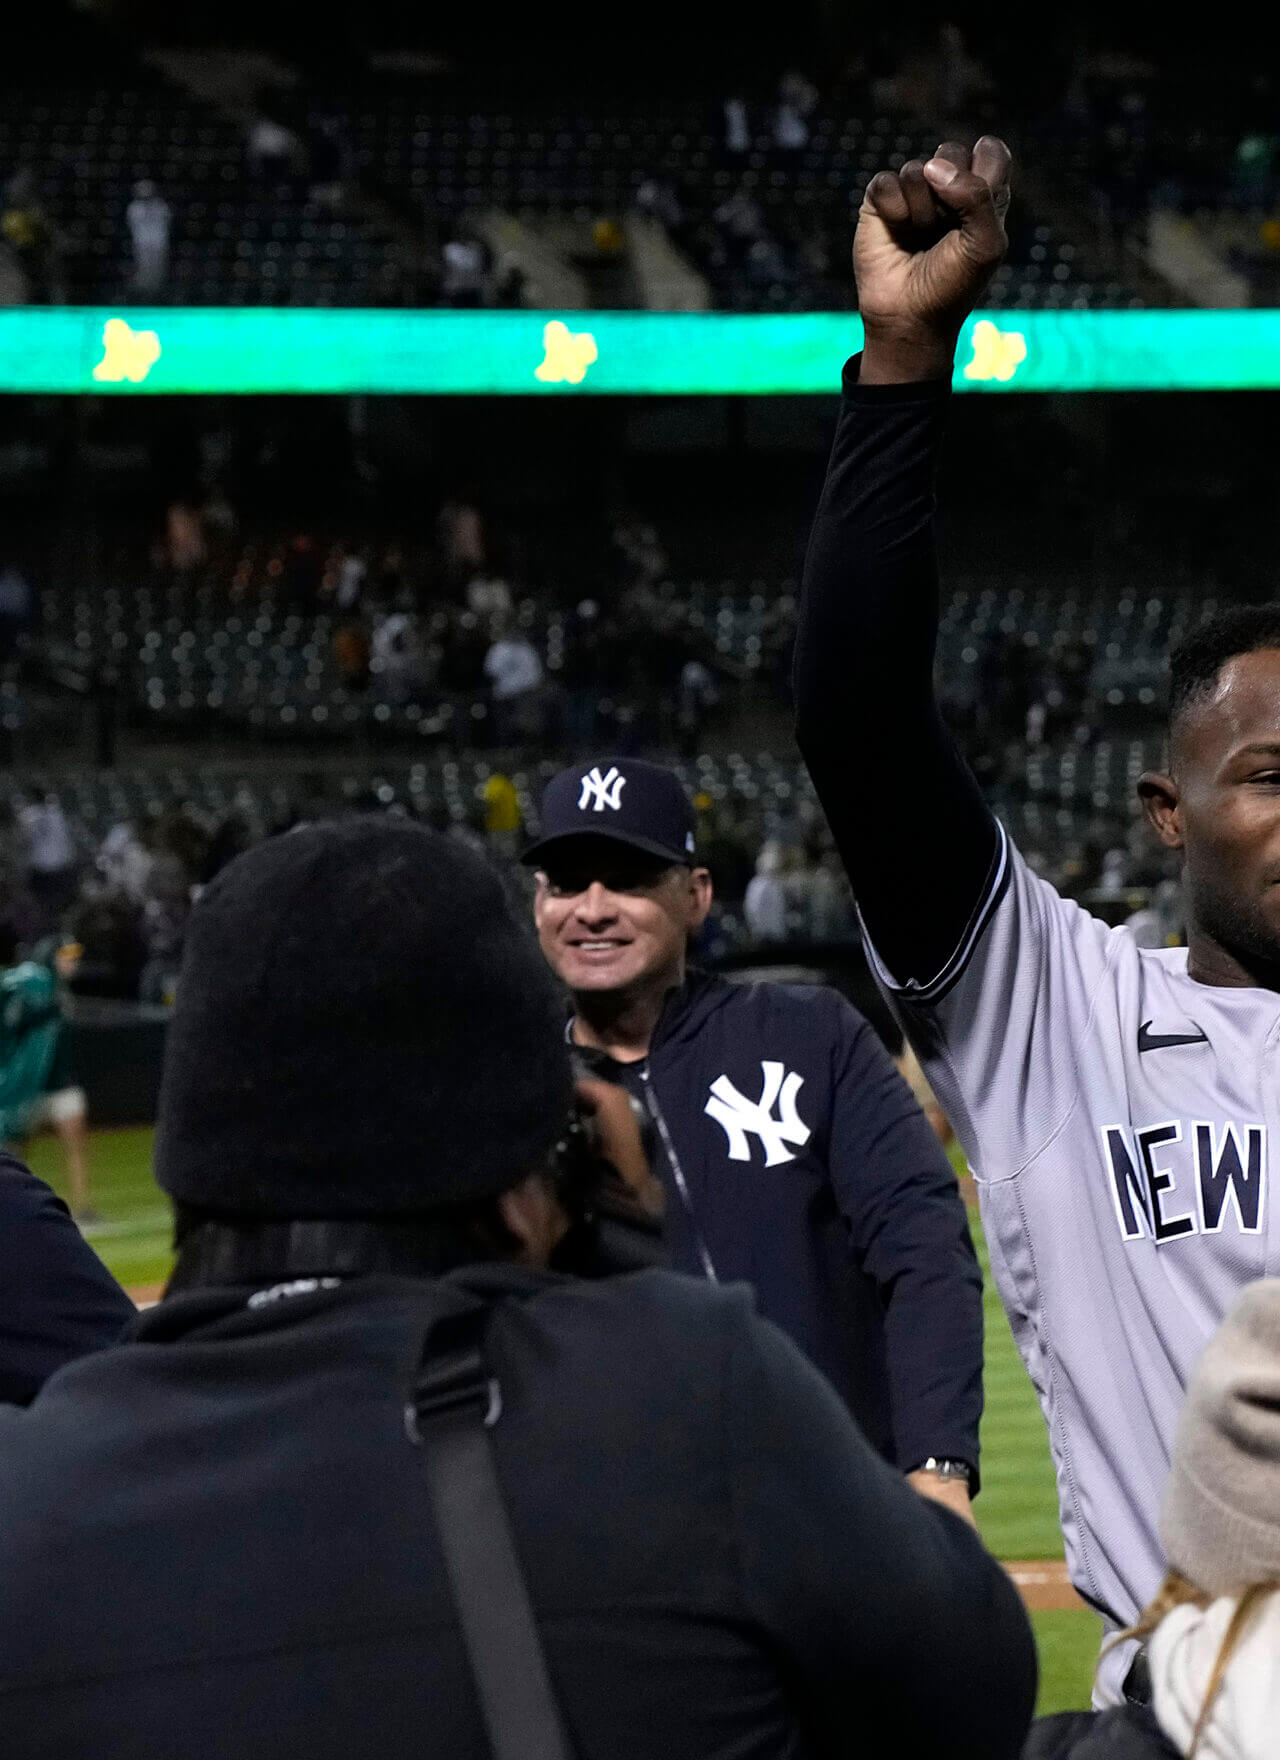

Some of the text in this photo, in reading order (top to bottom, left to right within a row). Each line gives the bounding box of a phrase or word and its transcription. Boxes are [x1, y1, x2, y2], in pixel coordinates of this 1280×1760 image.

[578, 767, 626, 811] NY
[704, 1060, 811, 1168] NY
[1100, 1119, 1267, 1245] NEW
